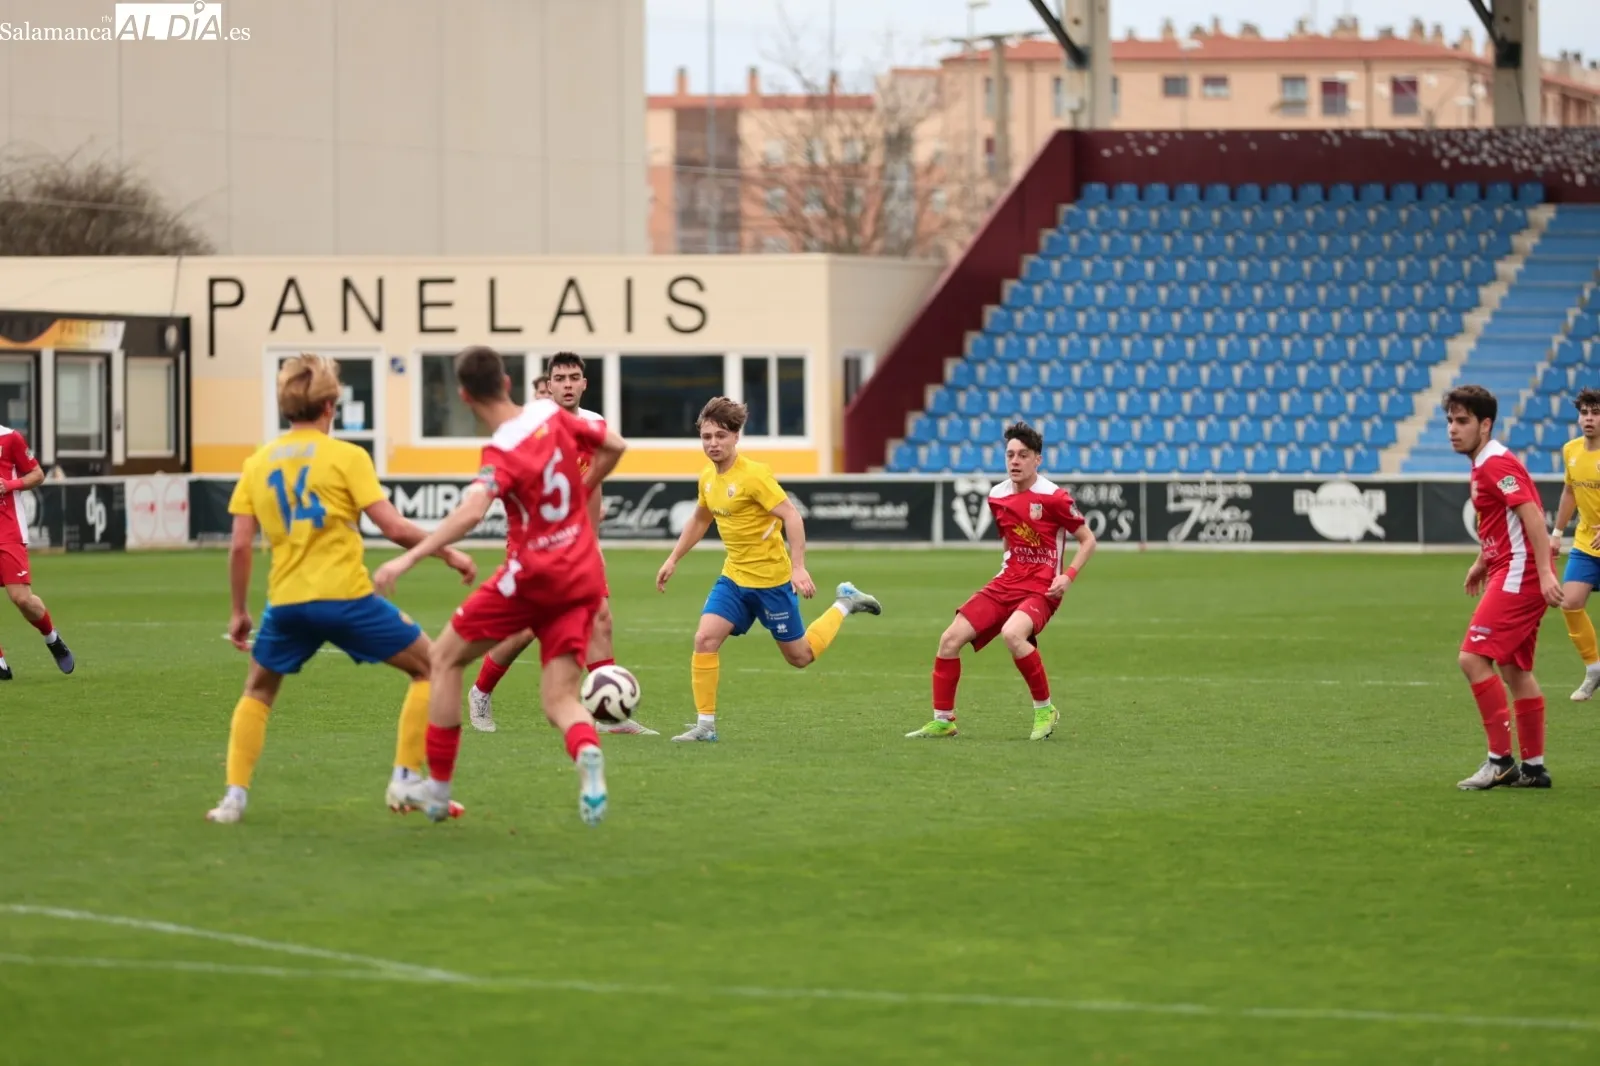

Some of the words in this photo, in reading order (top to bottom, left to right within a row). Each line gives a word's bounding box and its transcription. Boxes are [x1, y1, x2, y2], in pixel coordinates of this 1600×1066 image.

[208, 275, 708, 357] PANELAIS
[266, 466, 326, 535] 14
[539, 448, 571, 522] 5
